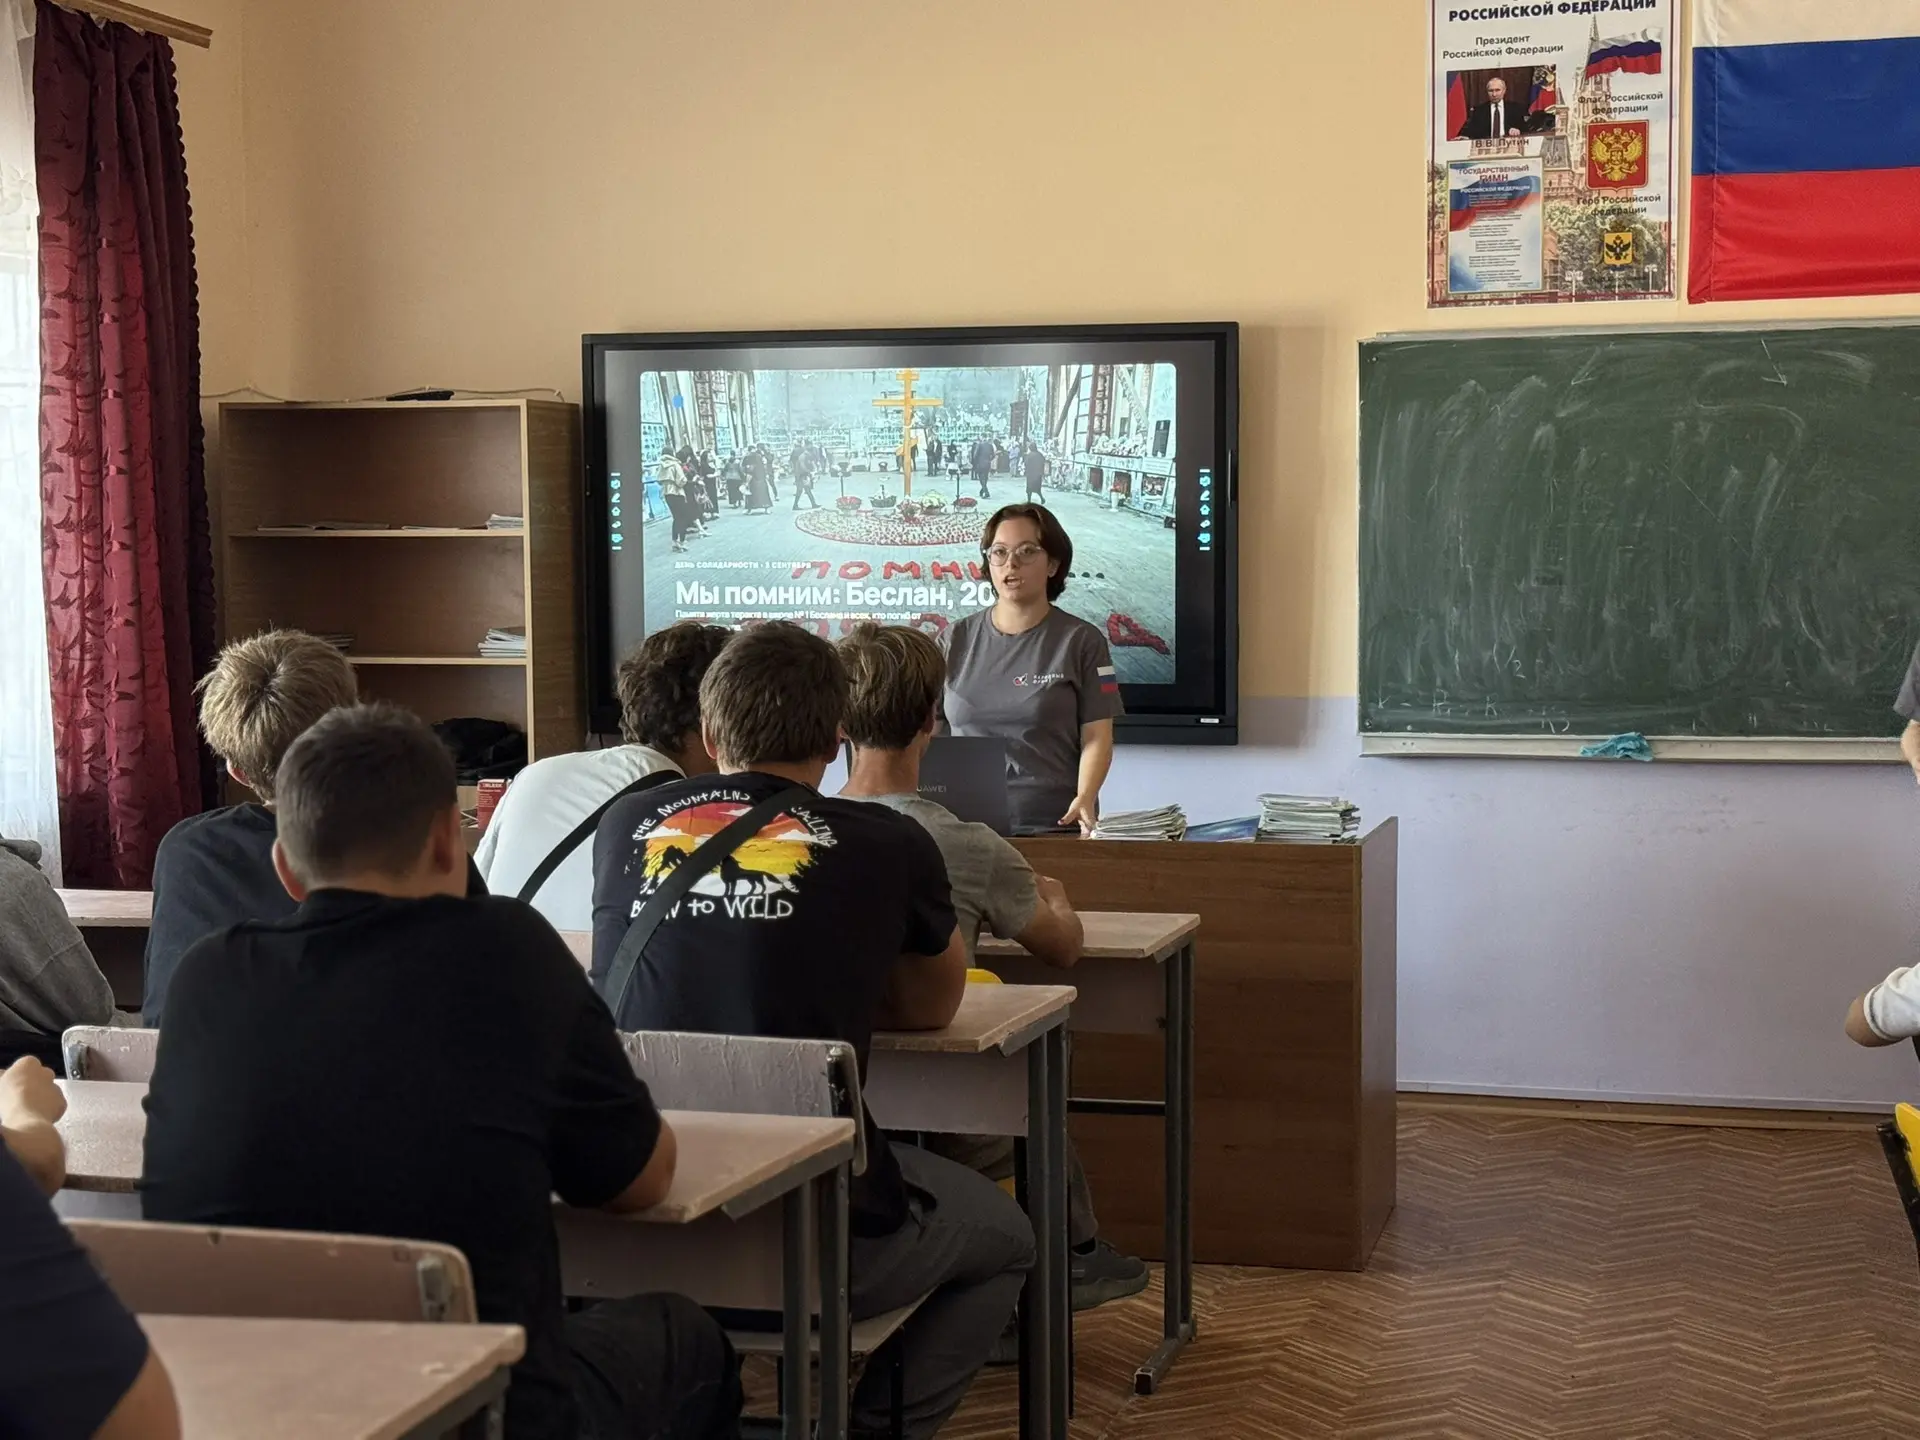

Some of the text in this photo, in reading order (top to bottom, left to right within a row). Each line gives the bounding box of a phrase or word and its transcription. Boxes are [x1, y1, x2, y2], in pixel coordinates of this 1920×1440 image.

[1449, 0, 1656, 22] РОССИЙСКОЙ ФЕДЕРАЦИИ
[1475, 35, 1531, 47] Президент
[1442, 45, 1564, 59] Российской Федерации
[1578, 91, 1664, 104] Флаг Российской
[1498, 138, 1529, 149] Путин
[1458, 164, 1530, 175] ГОСУДАРСТВЕННЫЙ
[1479, 174, 1509, 183] ГИМН
[1577, 194, 1661, 206] Герб Российской
[674, 561, 695, 569] ДЕНЬ
[696, 561, 759, 570] СОЛИДАРНОСТИ
[771, 561, 812, 569] СЕНТЯБРЯ
[676, 581, 996, 610] Мы помним: Беслан, 20
[810, 611, 843, 620] Беслана
[916, 784, 947, 793] UAWEI
[630, 900, 681, 920] BN
[723, 894, 793, 920] WILD
